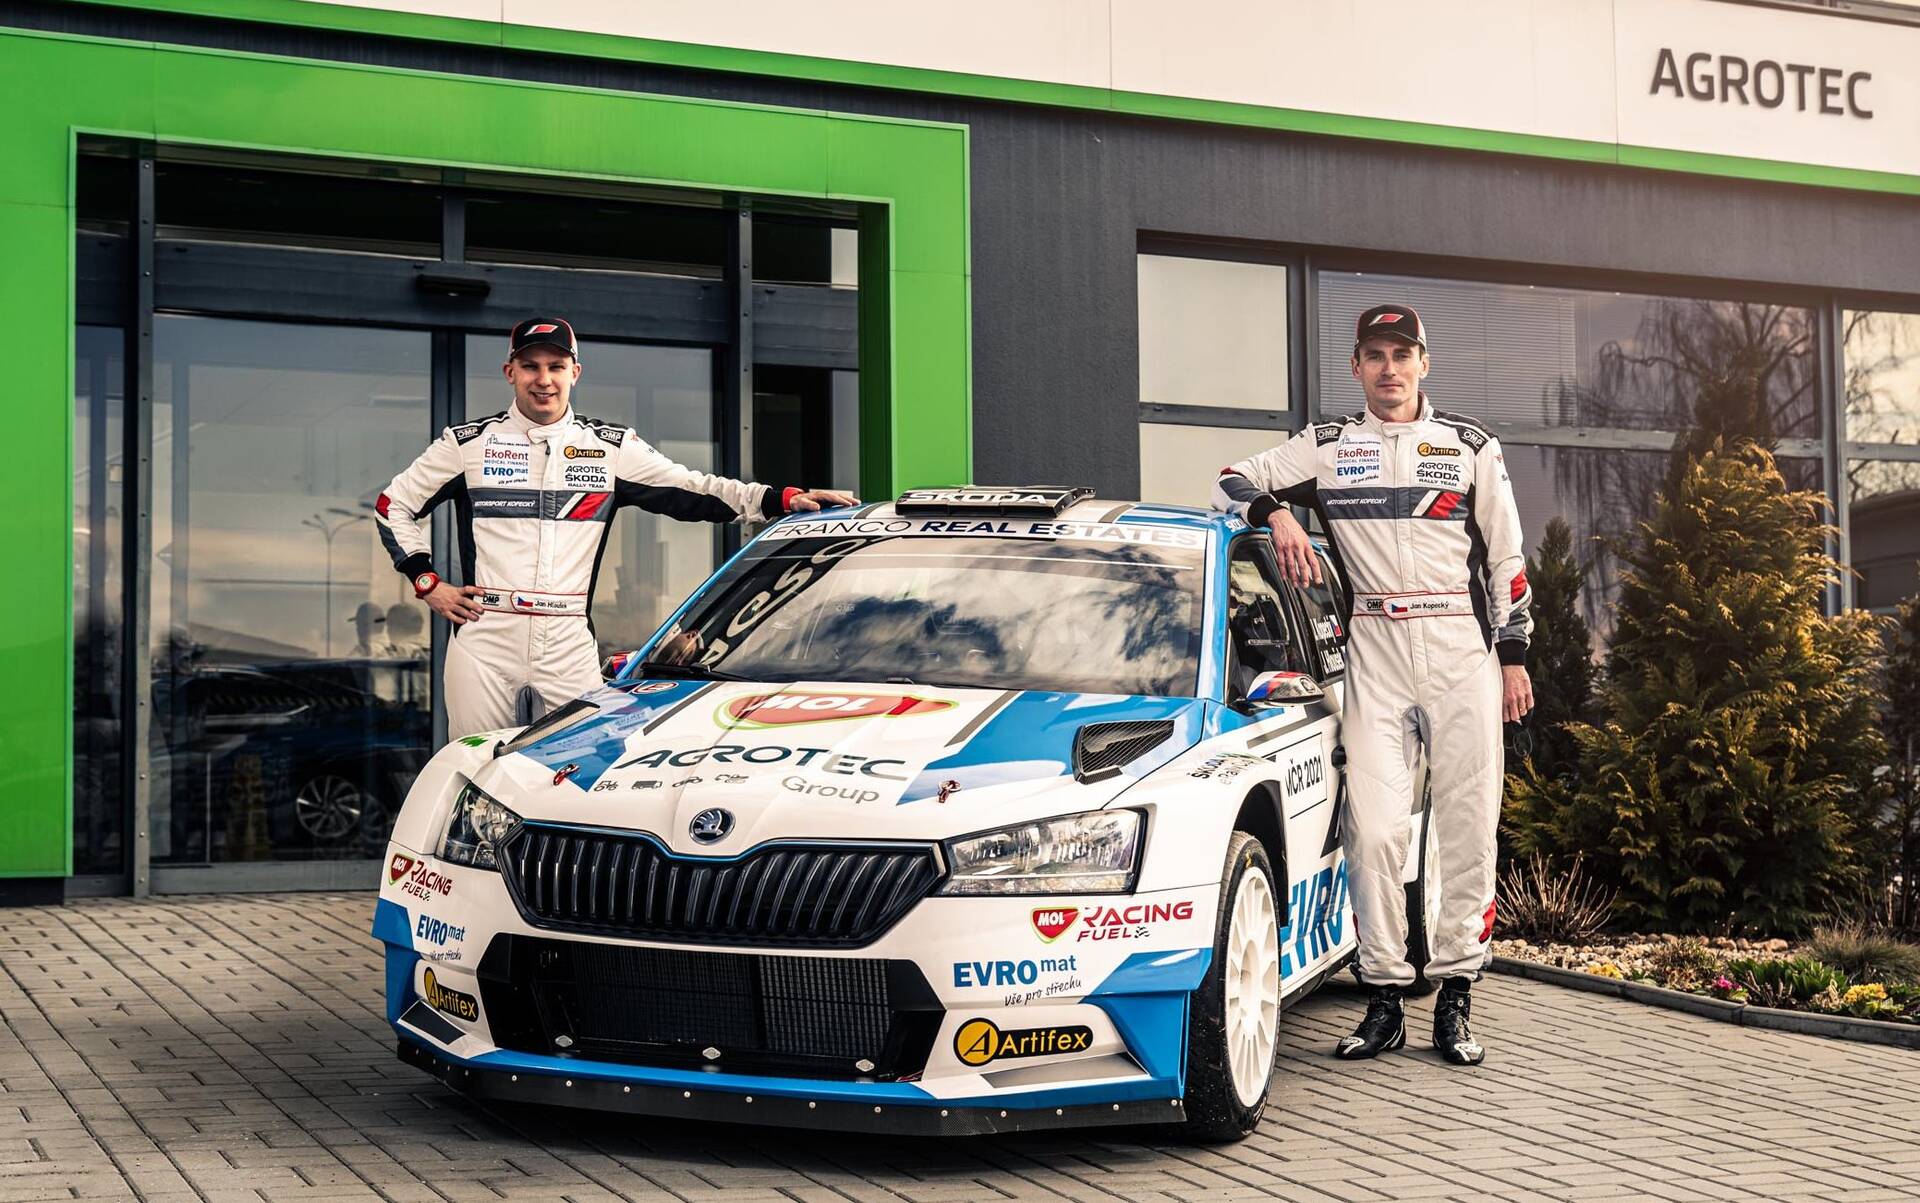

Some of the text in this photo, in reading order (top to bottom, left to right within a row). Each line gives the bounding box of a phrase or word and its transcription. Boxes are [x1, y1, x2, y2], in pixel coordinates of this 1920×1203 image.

[1650, 48, 1873, 119] AGROTEC
[457, 427, 479, 439] OMP
[600, 430, 622, 442] OMP
[1317, 429, 1338, 439] OMP
[1463, 431, 1487, 447] OMP
[485, 449, 529, 460] EkoRent
[1337, 448, 1380, 459] EkoRent
[483, 467, 514, 476] EVRO
[565, 465, 608, 474] AGROTEC
[1337, 466, 1366, 476] EVRO
[1416, 469, 1460, 482] ŠKODA
[1417, 462, 1461, 473] AGROTEC
[565, 473, 607, 483] ŠKODA
[767, 520, 1200, 547] FRANCO REAL ESTATES
[482, 595, 500, 604] OMP
[1423, 601, 1449, 610] Kopecký
[744, 695, 875, 711] MOL
[612, 745, 909, 781] AGROTEC
[1304, 754, 1324, 788] 2021
[782, 775, 880, 804] Group
[392, 857, 408, 871] MOL
[411, 860, 452, 896] RACING
[401, 881, 424, 898] FUEL
[1037, 911, 1066, 927] MOL
[1083, 901, 1194, 928] RACING
[1279, 859, 1350, 981] EVRO
[416, 914, 465, 946] EVRO mat
[1077, 927, 1132, 942] FUEL
[953, 955, 1077, 987] EVRO mat
[1004, 976, 1082, 1007] Vše pro střechu
[440, 988, 477, 1018] Artifex
[999, 1029, 1088, 1055] Artifex
